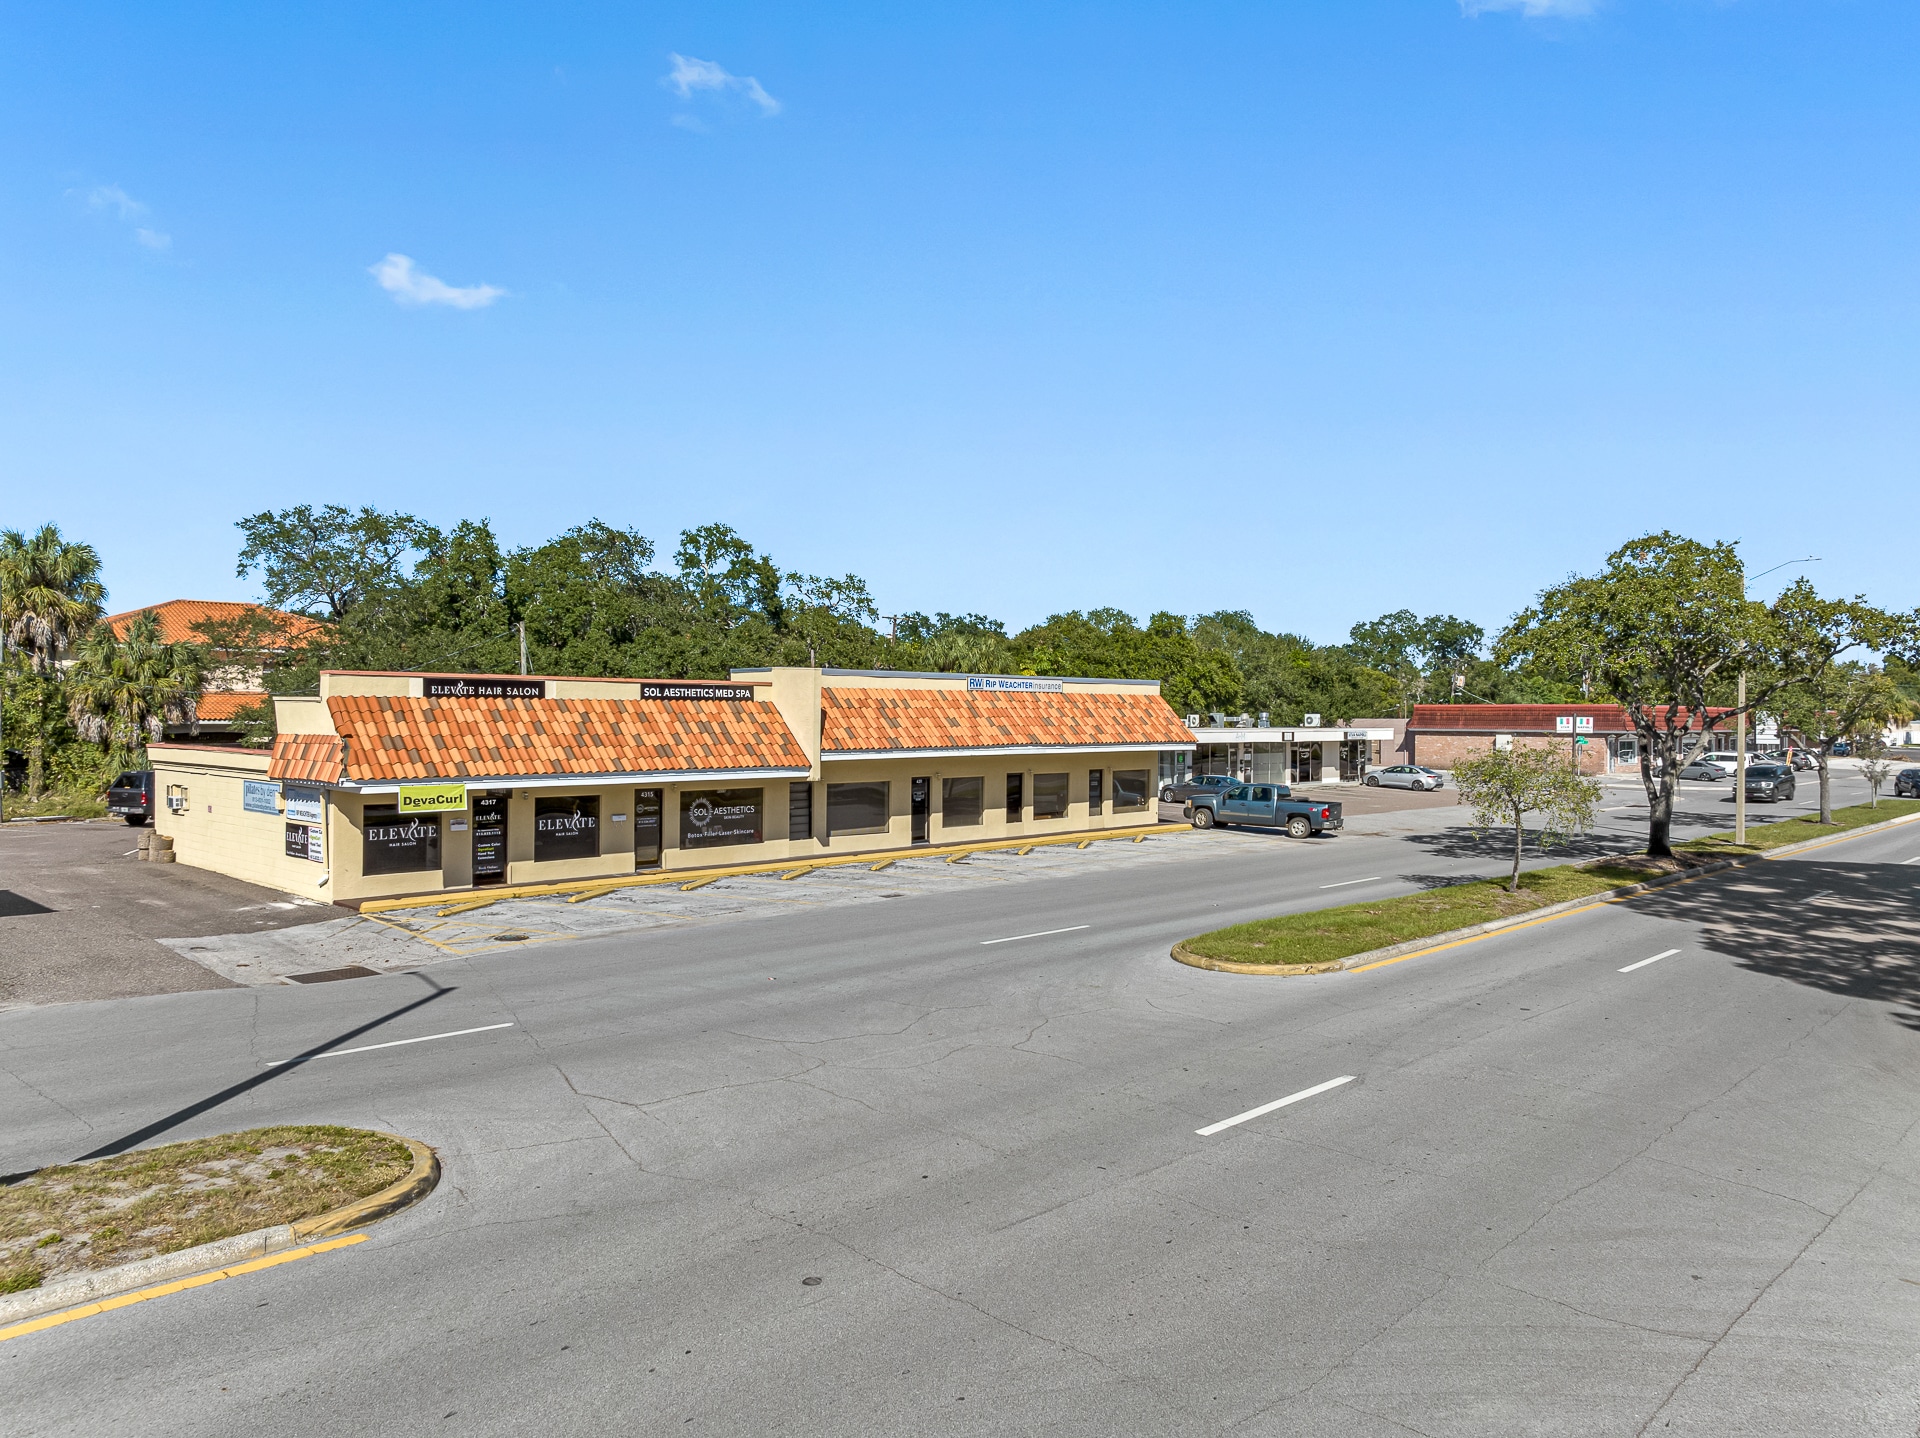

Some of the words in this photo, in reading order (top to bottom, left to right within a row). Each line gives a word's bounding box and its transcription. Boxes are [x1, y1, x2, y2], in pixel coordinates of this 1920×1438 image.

[431, 680, 475, 697] ELEVATE
[478, 686, 503, 696] HAIR
[506, 687, 540, 696] SALON
[985, 679, 997, 688] RIP
[643, 687, 661, 697] SOL
[663, 688, 714, 698] AESTHETICS
[715, 689, 734, 698] MED
[735, 689, 751, 698] SPA
[266, 786, 279, 798] den
[403, 794, 463, 807] DevaCurl
[475, 811, 502, 822] ELEVATE
[693, 808, 708, 817] SOL
[713, 805, 755, 815] AESTHETICS
[538, 809, 596, 832] ELEVATE
[368, 817, 437, 842] ELEVATE
